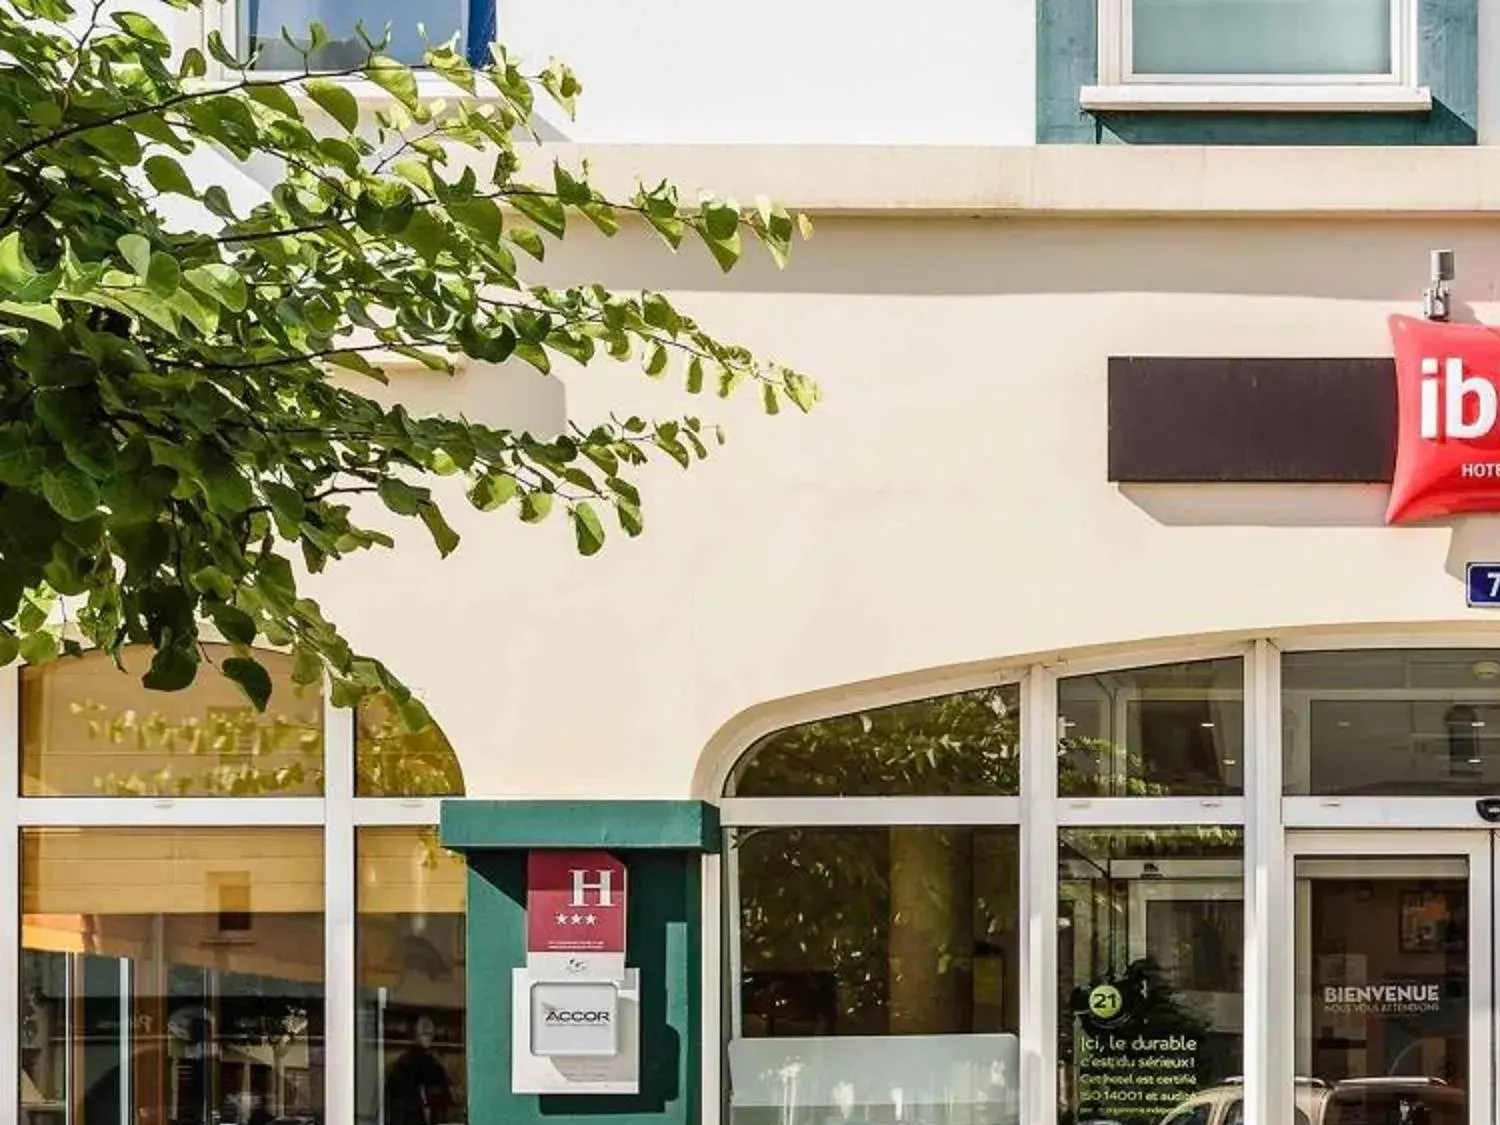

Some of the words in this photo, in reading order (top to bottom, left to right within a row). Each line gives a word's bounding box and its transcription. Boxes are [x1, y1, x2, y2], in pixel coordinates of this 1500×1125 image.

[568, 869, 616, 907] H
[1094, 993, 1116, 1009] 21
[1325, 984, 1440, 1002] BIENVENUE
[545, 1010, 611, 1023] ACCOR
[1081, 1035, 1105, 1053] Ici,
[1109, 1034, 1126, 1050] le
[1132, 1034, 1197, 1051] durable
[1104, 1091, 1143, 1101] 14001
